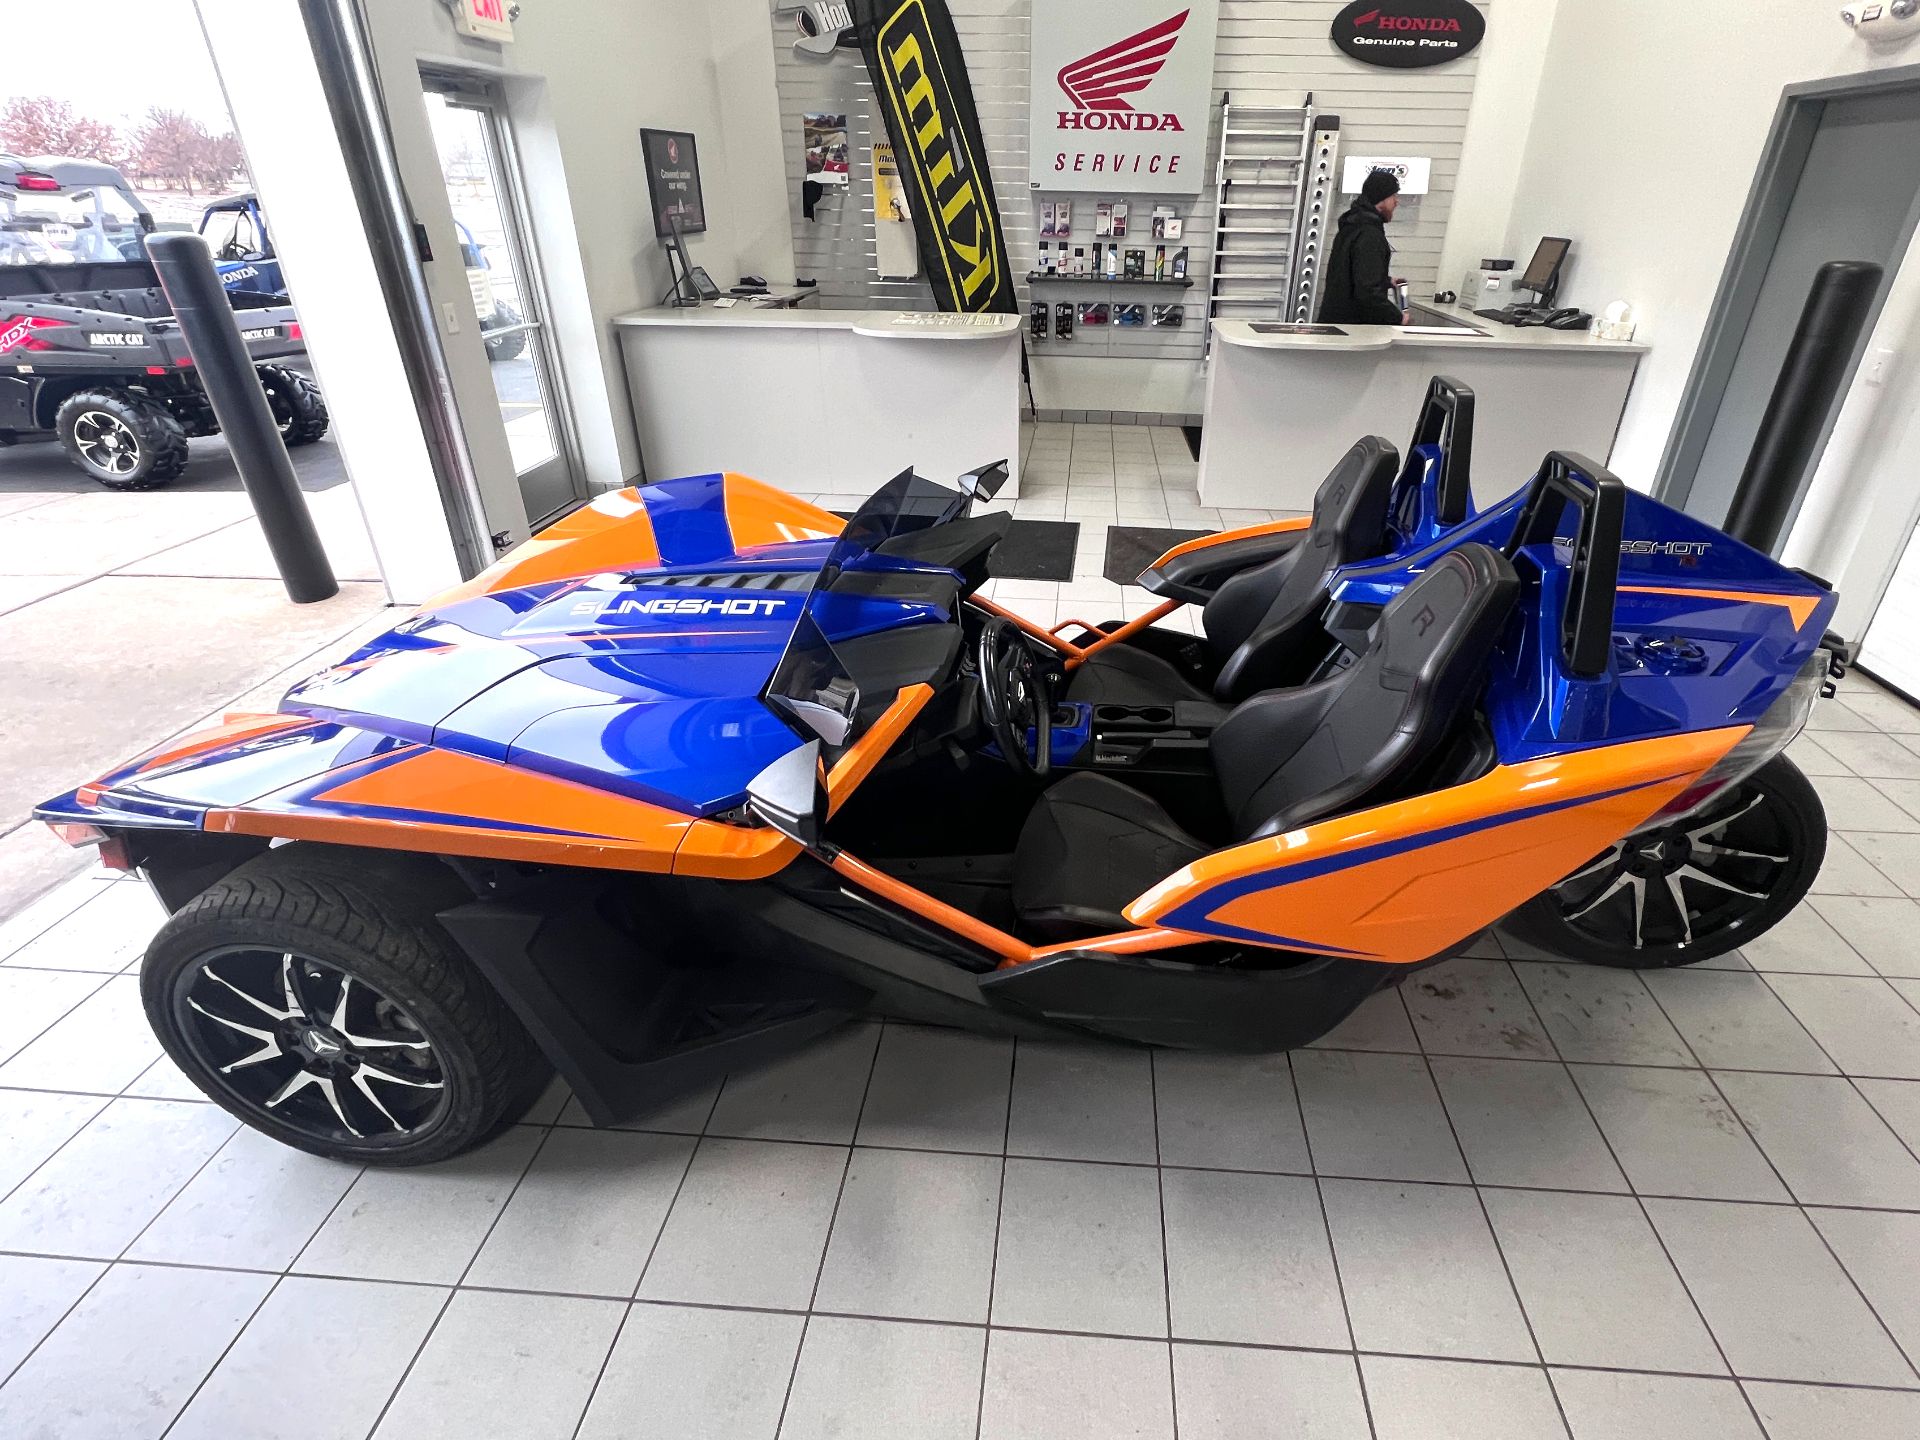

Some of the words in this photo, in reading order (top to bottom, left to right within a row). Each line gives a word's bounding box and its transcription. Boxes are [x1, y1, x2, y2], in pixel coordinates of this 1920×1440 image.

[814, 1, 854, 33] Hon
[1378, 16, 1461, 32] HONDA
[1353, 36, 1416, 46] Genuine
[1419, 38, 1458, 48] Parts
[1057, 111, 1185, 131] HONDA
[1054, 152, 1181, 174] SERVICE
[90, 333, 125, 345] ARCTIC
[125, 333, 144, 345] CAT
[570, 599, 786, 616] SLINGSHOT
